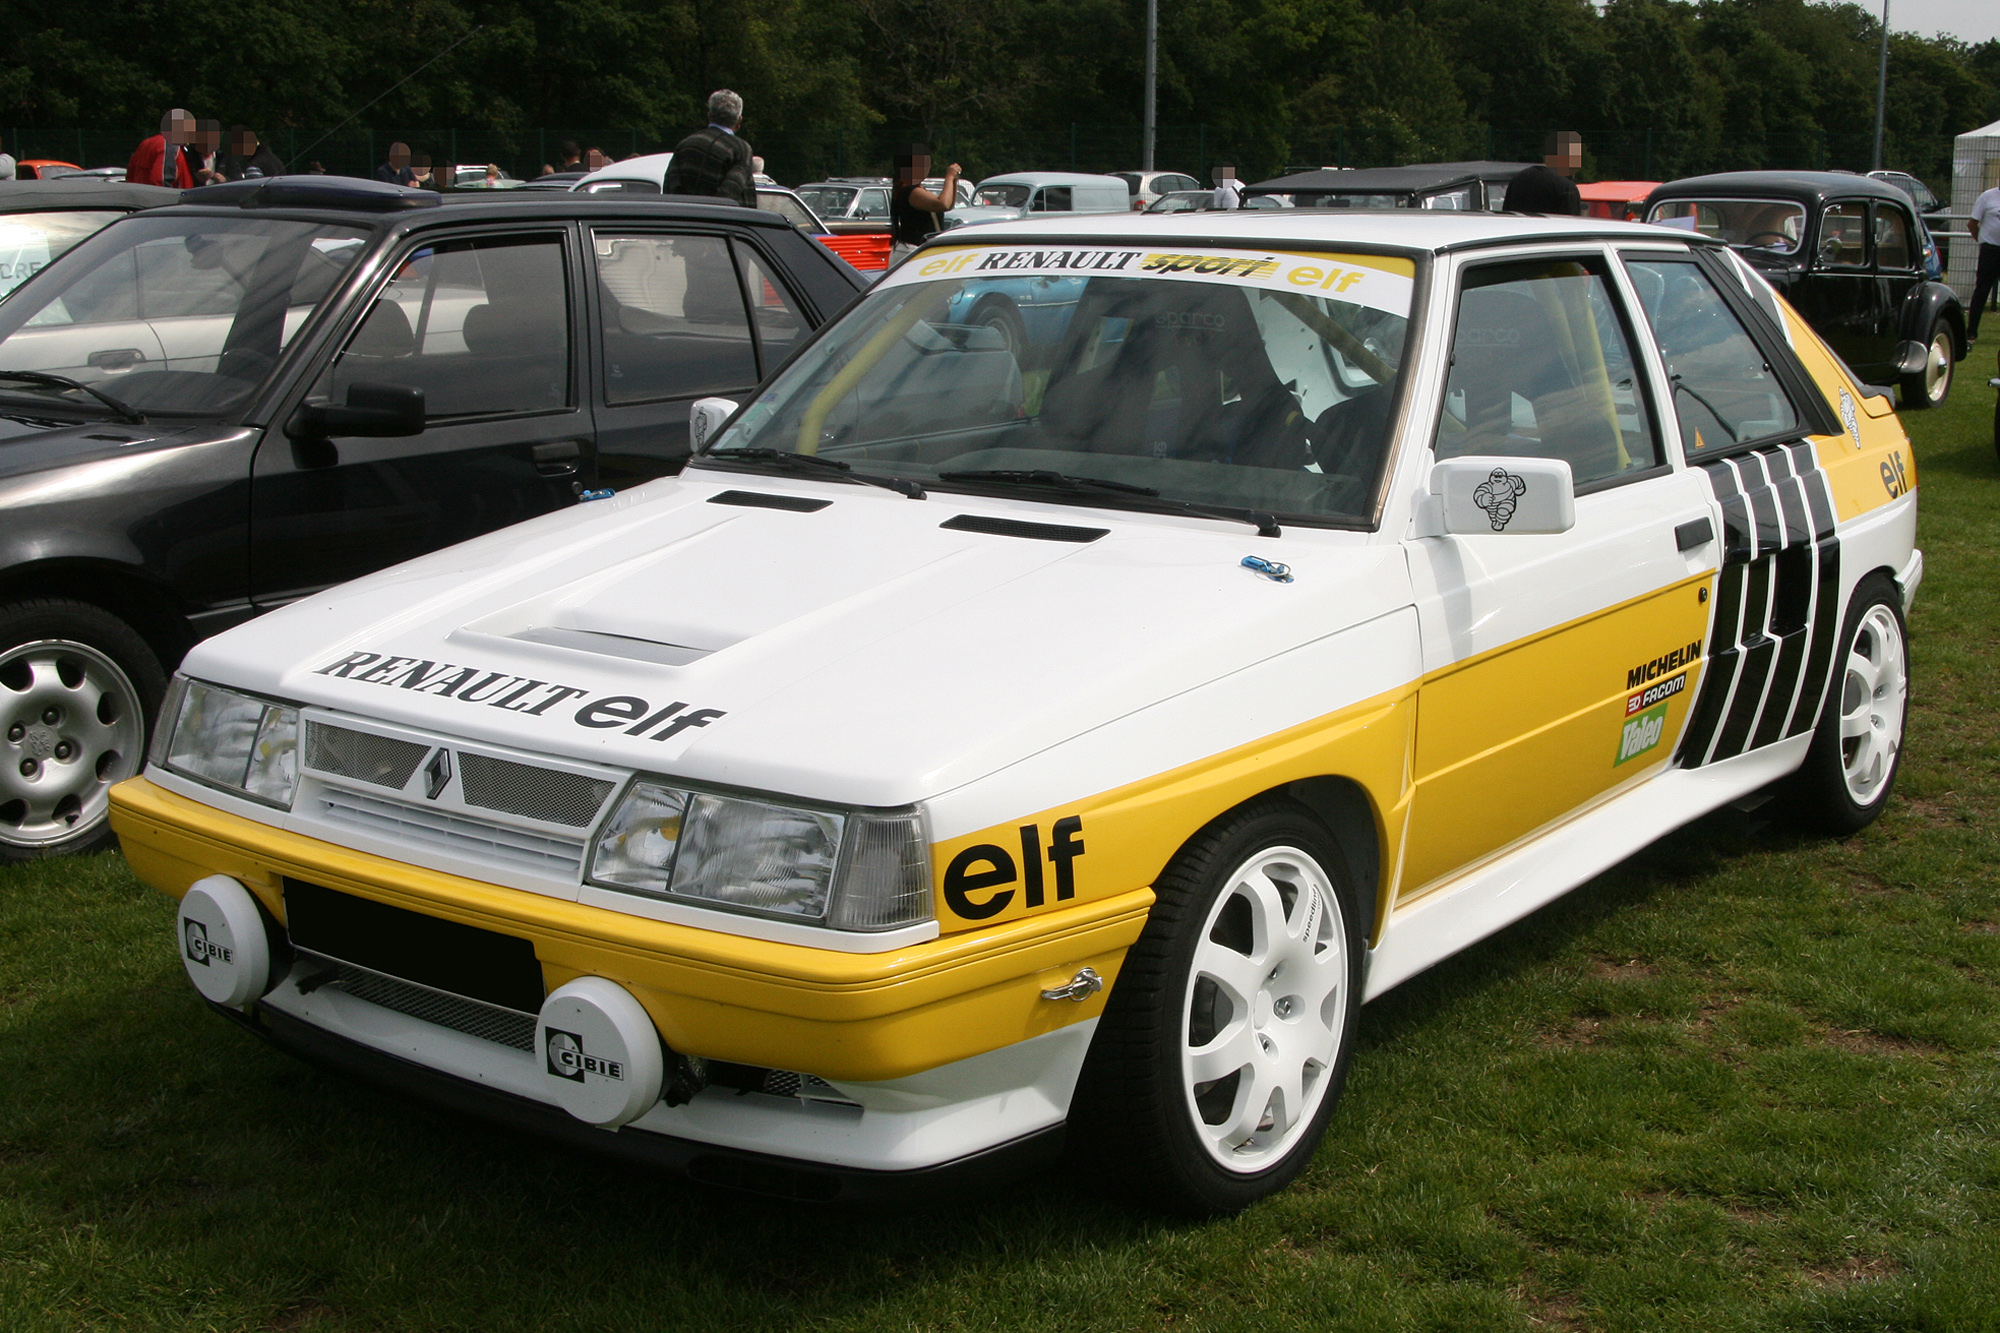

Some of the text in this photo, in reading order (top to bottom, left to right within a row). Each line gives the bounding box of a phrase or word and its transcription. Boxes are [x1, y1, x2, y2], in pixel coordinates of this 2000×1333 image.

[918, 253, 980, 277] elf
[974, 251, 1142, 271] RENAULT
[1286, 266, 1365, 292] elf
[1879, 450, 1908, 499] elf
[1626, 639, 1701, 690] MICHELIN
[312, 650, 728, 742] RENAULT elf
[1642, 675, 1685, 707] FACOM
[1620, 715, 1664, 761] Valeo
[943, 814, 1085, 920] elf
